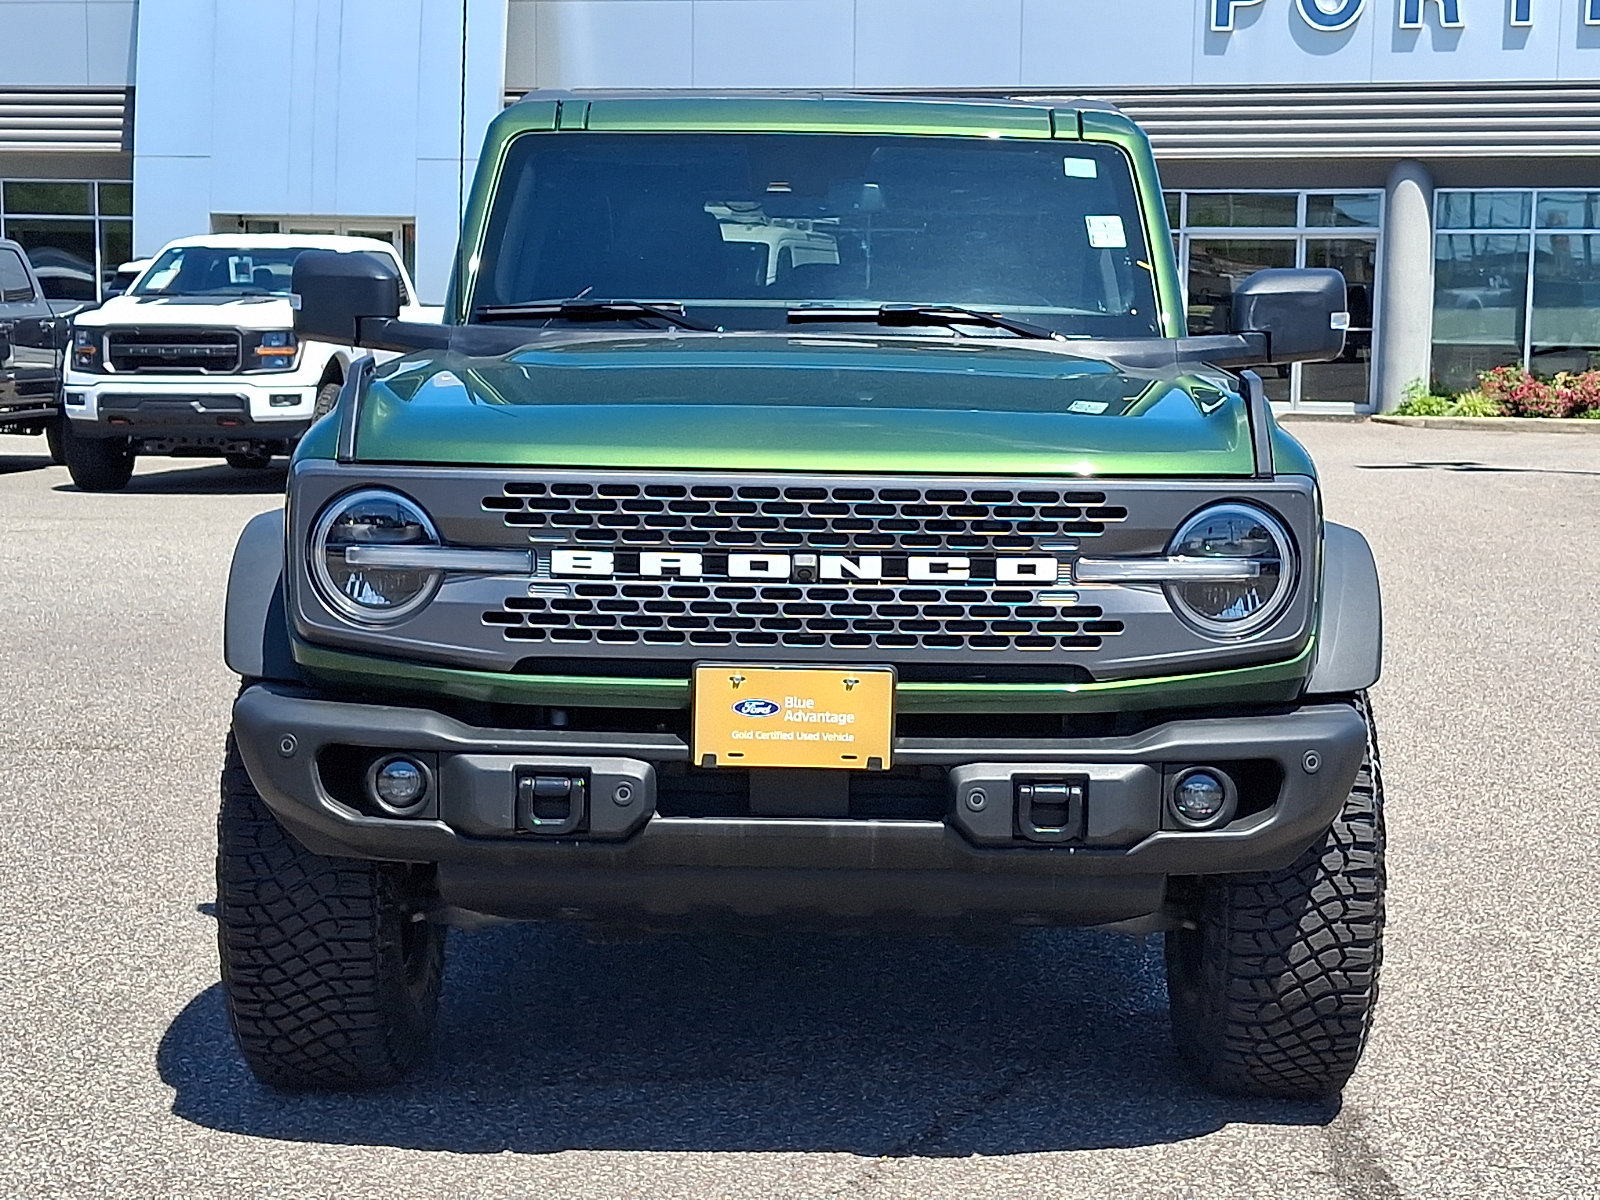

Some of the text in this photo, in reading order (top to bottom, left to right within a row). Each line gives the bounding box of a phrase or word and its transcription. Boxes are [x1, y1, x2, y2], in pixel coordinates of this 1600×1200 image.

[551, 550, 1058, 581] BRONCO
[740, 700, 773, 715] Ford
[784, 696, 815, 709] Blue
[784, 710, 855, 725] Advantage
[731, 730, 855, 742] Gold Certified Used Vehicle
